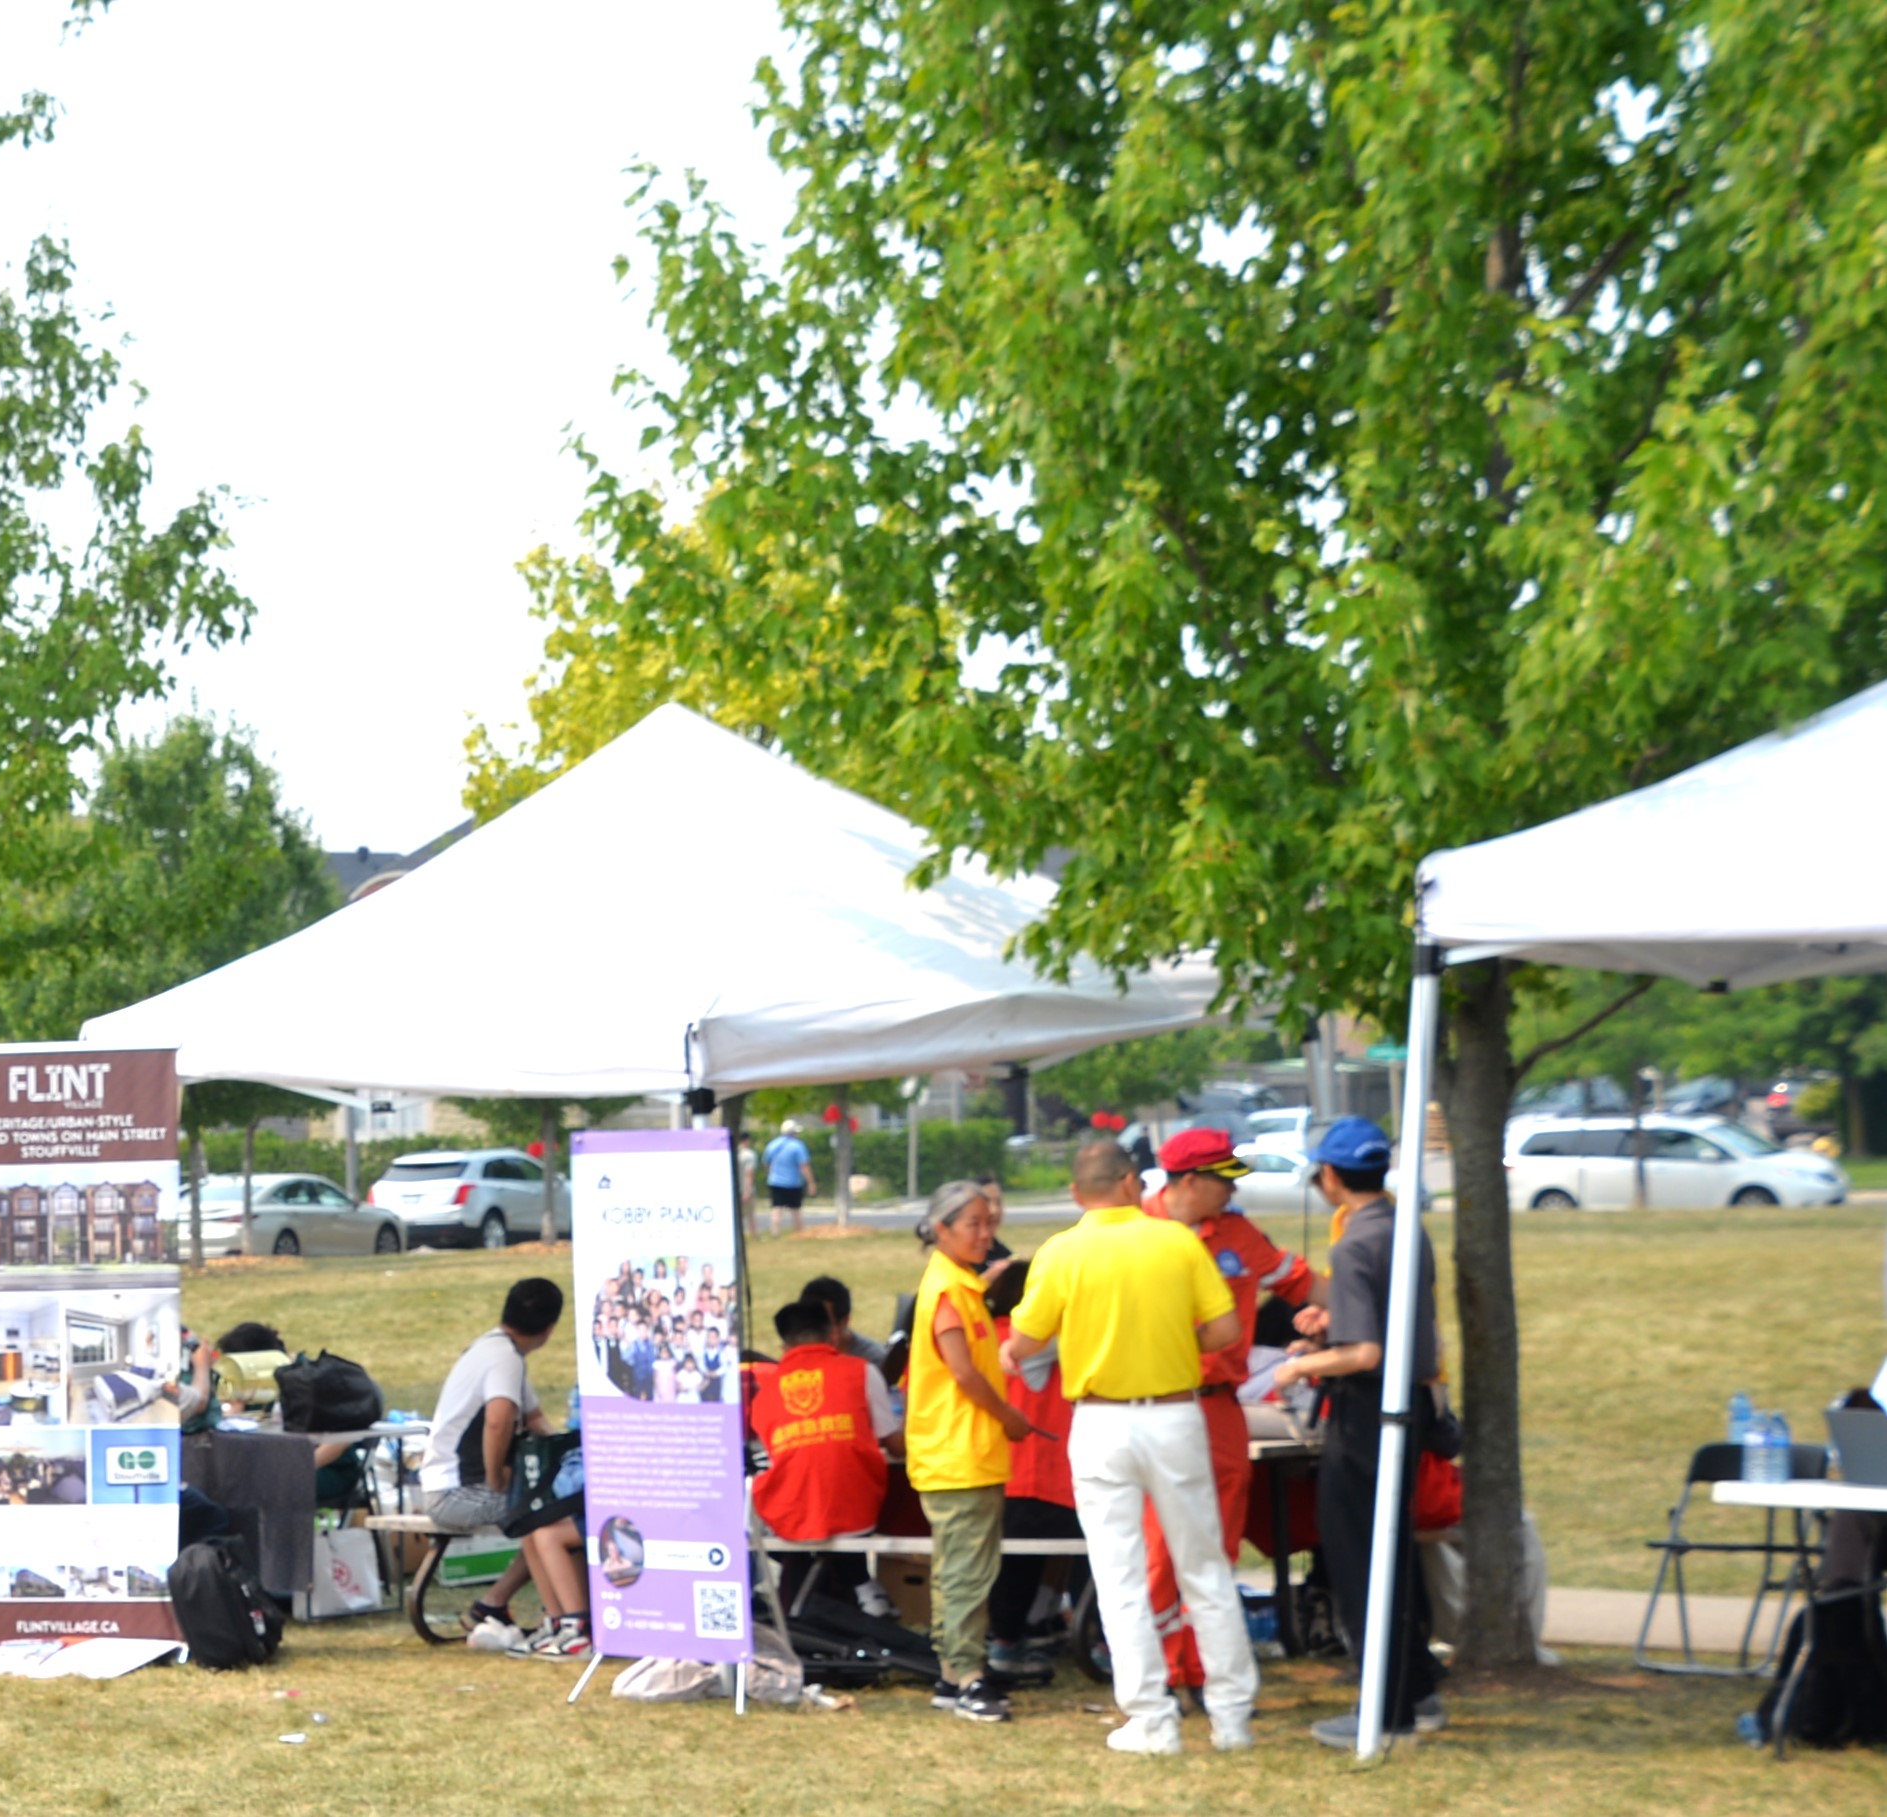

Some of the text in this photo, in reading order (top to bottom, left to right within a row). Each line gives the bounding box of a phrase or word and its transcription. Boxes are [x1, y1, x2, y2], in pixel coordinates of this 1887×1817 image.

[8, 1063, 111, 1103] FLINT
[12, 1131, 57, 1144] TOWNS
[61, 1130, 82, 1143] ON
[85, 1129, 119, 1142] MAIN
[122, 1127, 167, 1141] STREET
[20, 1144, 101, 1159] STOUFFVILLE
[659, 1205, 715, 1224] PIANO
[117, 1450, 157, 1470] GO
[15, 1619, 120, 1634] FLINTVILLAGE.CA
